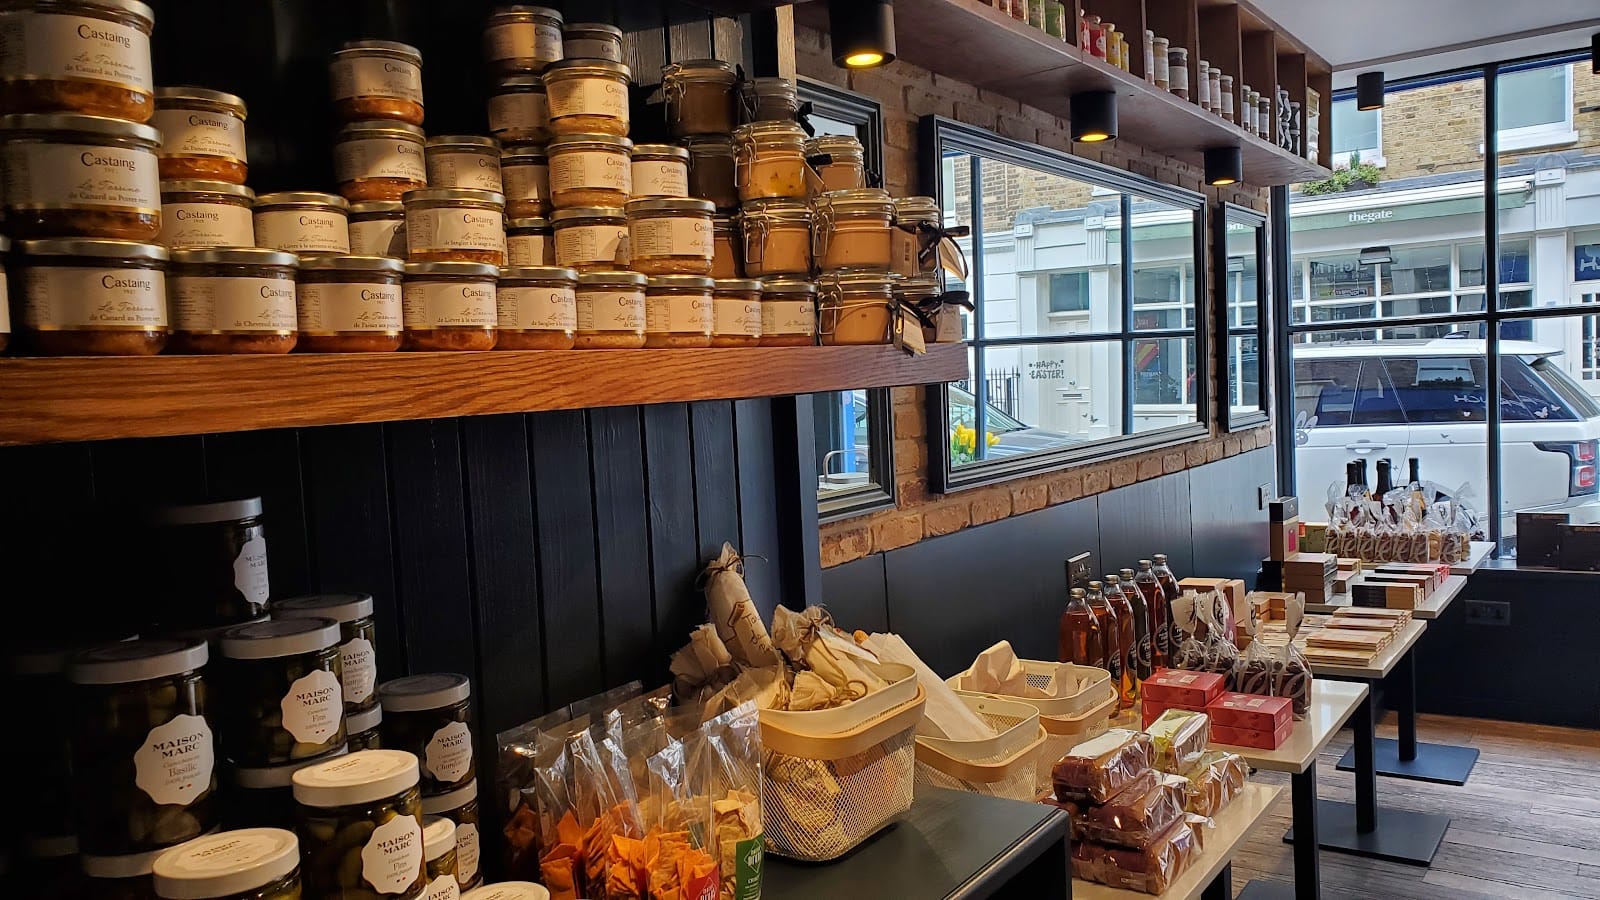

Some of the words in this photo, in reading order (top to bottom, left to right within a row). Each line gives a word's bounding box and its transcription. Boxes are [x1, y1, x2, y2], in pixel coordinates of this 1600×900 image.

[77, 23, 131, 48] Castaing
[189, 114, 228, 131] Castaing
[81, 152, 136, 171] Castaing
[176, 209, 219, 221] Castaing
[300, 215, 334, 228] Castaing
[463, 213, 494, 226] Castaing
[1348, 210, 1393, 224] thegate
[101, 274, 151, 291] Castaing
[361, 289, 395, 303] Castaing
[462, 287, 492, 299] Castaing
[1036, 360, 1059, 369] HAPPY
[1031, 369, 1065, 379] EASTER!
[344, 657, 367, 668] MARC
[296, 687, 334, 701] MAISON
[303, 694, 331, 707] MARC
[152, 731, 204, 752] MAISON
[437, 731, 466, 744] MAISON
[442, 738, 464, 749] MARC
[161, 742, 200, 759] MARC
[376, 831, 415, 850] MAISON
[383, 840, 412, 855] MARC
